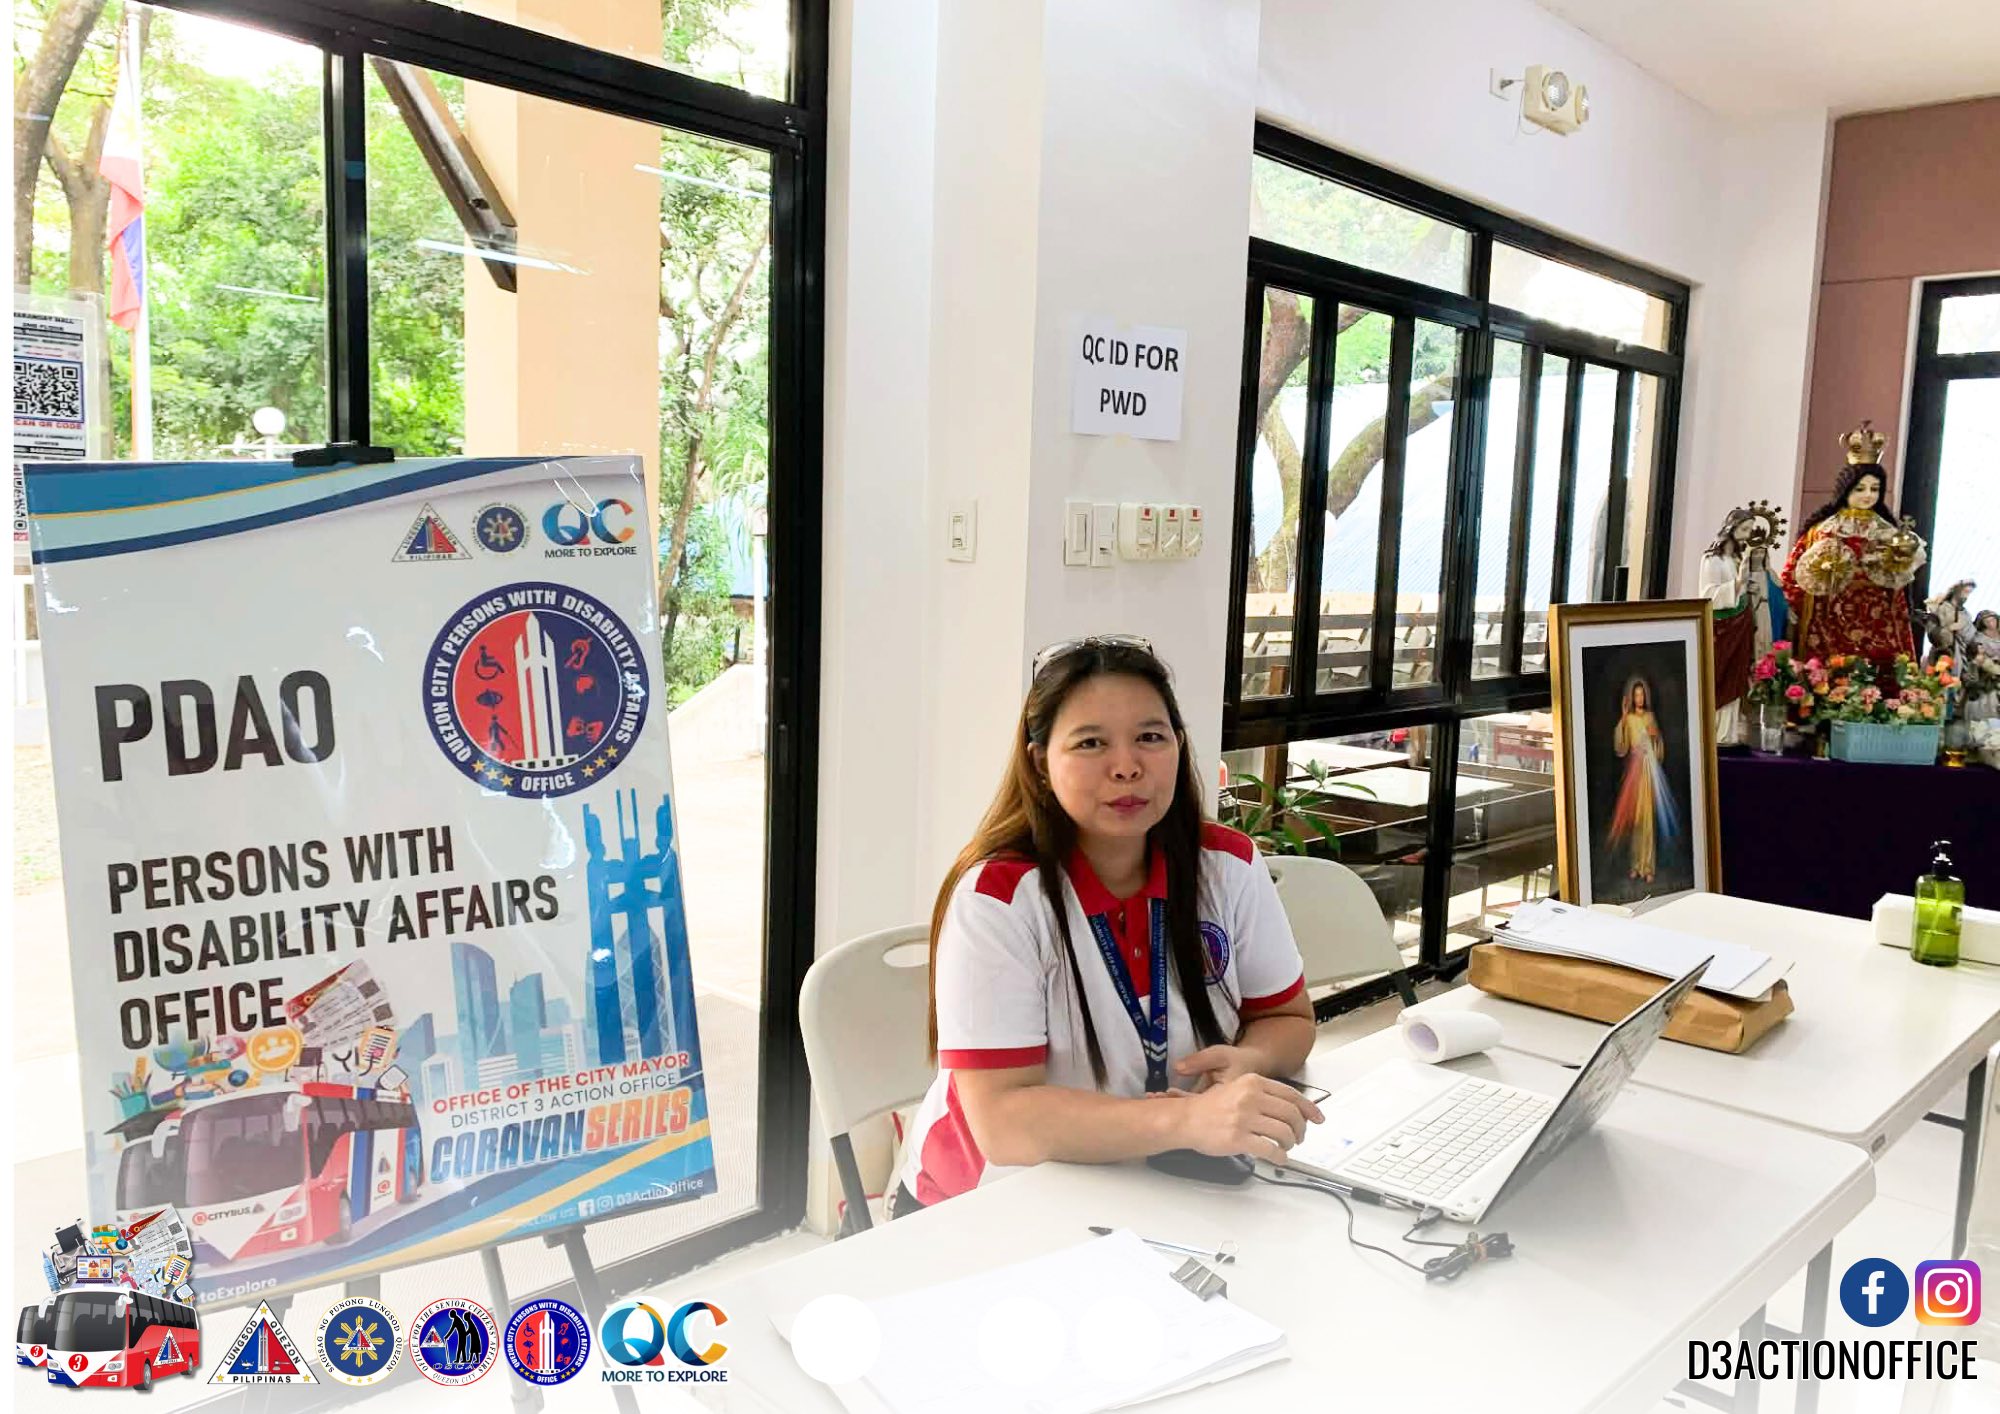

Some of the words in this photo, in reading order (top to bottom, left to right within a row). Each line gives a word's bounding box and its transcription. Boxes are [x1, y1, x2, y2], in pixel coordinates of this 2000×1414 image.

[1082, 334, 1105, 365] QC
[1109, 339, 1128, 366] ID
[1134, 344, 1178, 372] FOR
[1099, 388, 1147, 416] PWD
[541, 498, 635, 546] QC
[544, 549, 577, 558] MORE
[578, 548, 592, 557] TO
[593, 546, 637, 556] EXPLORE
[441, 597, 506, 657] PERSONS
[507, 589, 557, 607] WITH
[562, 594, 638, 668] DISABILITY
[431, 657, 451, 697] CITY
[94, 669, 335, 783] PDAO
[432, 702, 472, 763] QUEZON
[521, 772, 575, 791] OFFICE
[108, 839, 330, 914] PERSONS
[344, 825, 454, 882] WITH
[113, 897, 372, 982] DISABILITY
[387, 875, 559, 943] AFFAIRS
[119, 977, 287, 1050] OFFICE
[433, 1088, 500, 1113] OFFICE
[507, 1083, 530, 1100] OF
[537, 1078, 570, 1094] THE
[576, 1068, 616, 1086] CITY
[623, 1053, 688, 1077] MAYOR
[452, 1106, 527, 1128] DISTRICT
[534, 1099, 544, 1112] 3
[551, 1085, 614, 1108] ACTION
[620, 1072, 676, 1094] OFFICE
